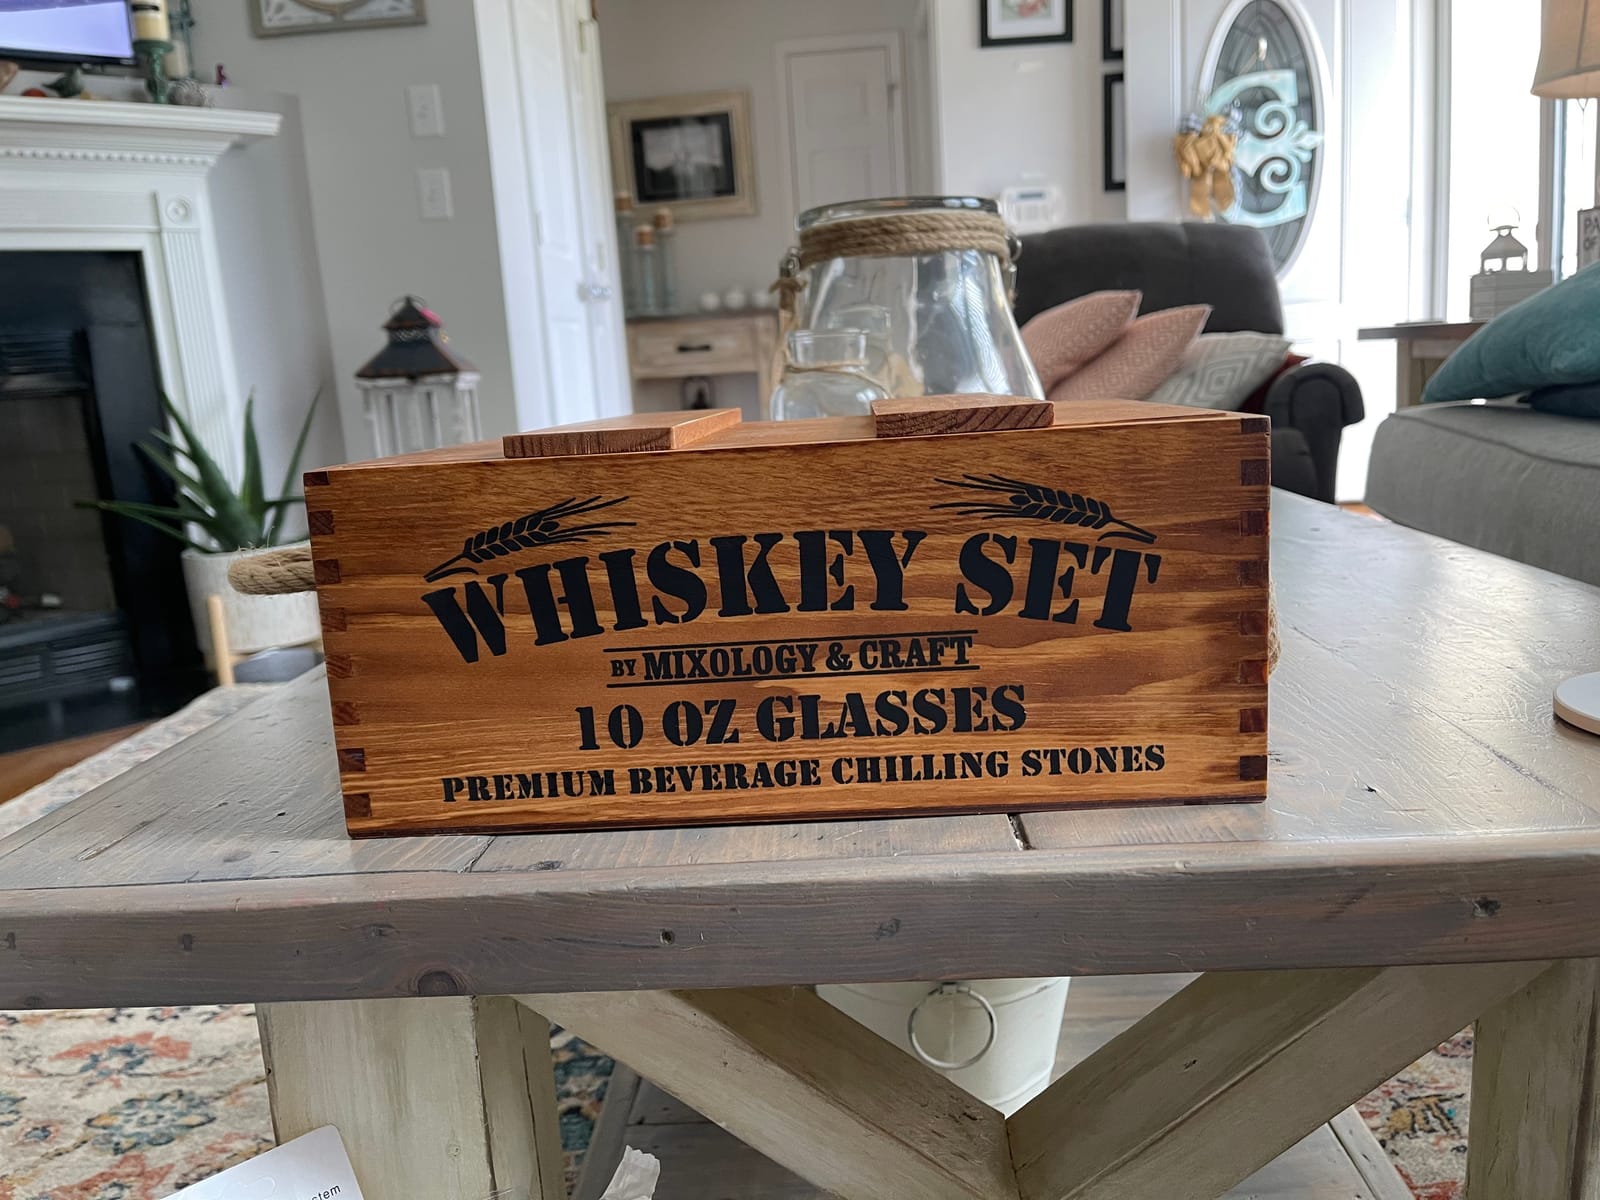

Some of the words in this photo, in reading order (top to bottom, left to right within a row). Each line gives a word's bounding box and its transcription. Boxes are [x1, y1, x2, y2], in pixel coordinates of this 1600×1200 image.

[421, 530, 927, 664] WHISKEY
[954, 533, 1162, 632] SET
[610, 659, 636, 677] BY
[643, 643, 816, 680] MIXOLOGY
[826, 642, 853, 671] &
[859, 636, 973, 670] CRAFT
[575, 704, 644, 751] 10
[662, 699, 740, 747] OZ
[756, 684, 1027, 742] GLASSES
[441, 769, 616, 802] PREMIUM
[628, 758, 822, 795] BEVERAGE
[831, 750, 1009, 785] CHILLING
[1021, 744, 1166, 777] STONES
